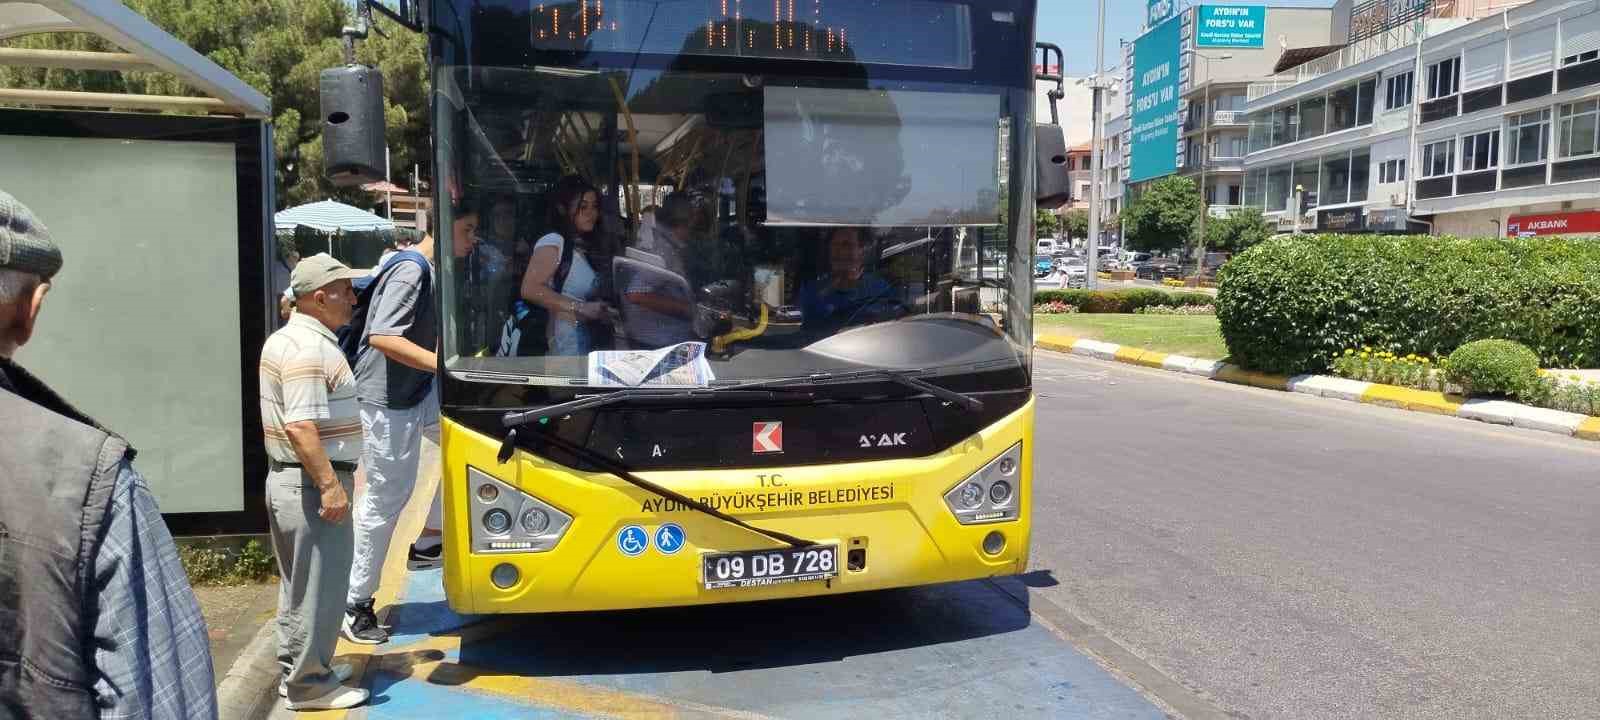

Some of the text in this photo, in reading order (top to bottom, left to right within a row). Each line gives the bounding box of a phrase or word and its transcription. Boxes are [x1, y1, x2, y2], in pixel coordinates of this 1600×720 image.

[1206, 19, 1255, 28] FORS'U VAR
[1160, 85, 1174, 103] VAR
[1527, 219, 1568, 230] AKBANK
[756, 474, 788, 488] T.C.
[808, 482, 895, 505] BELEDİYESİ
[716, 550, 833, 579] 09 DB 728
[740, 578, 773, 587] DESTAN
